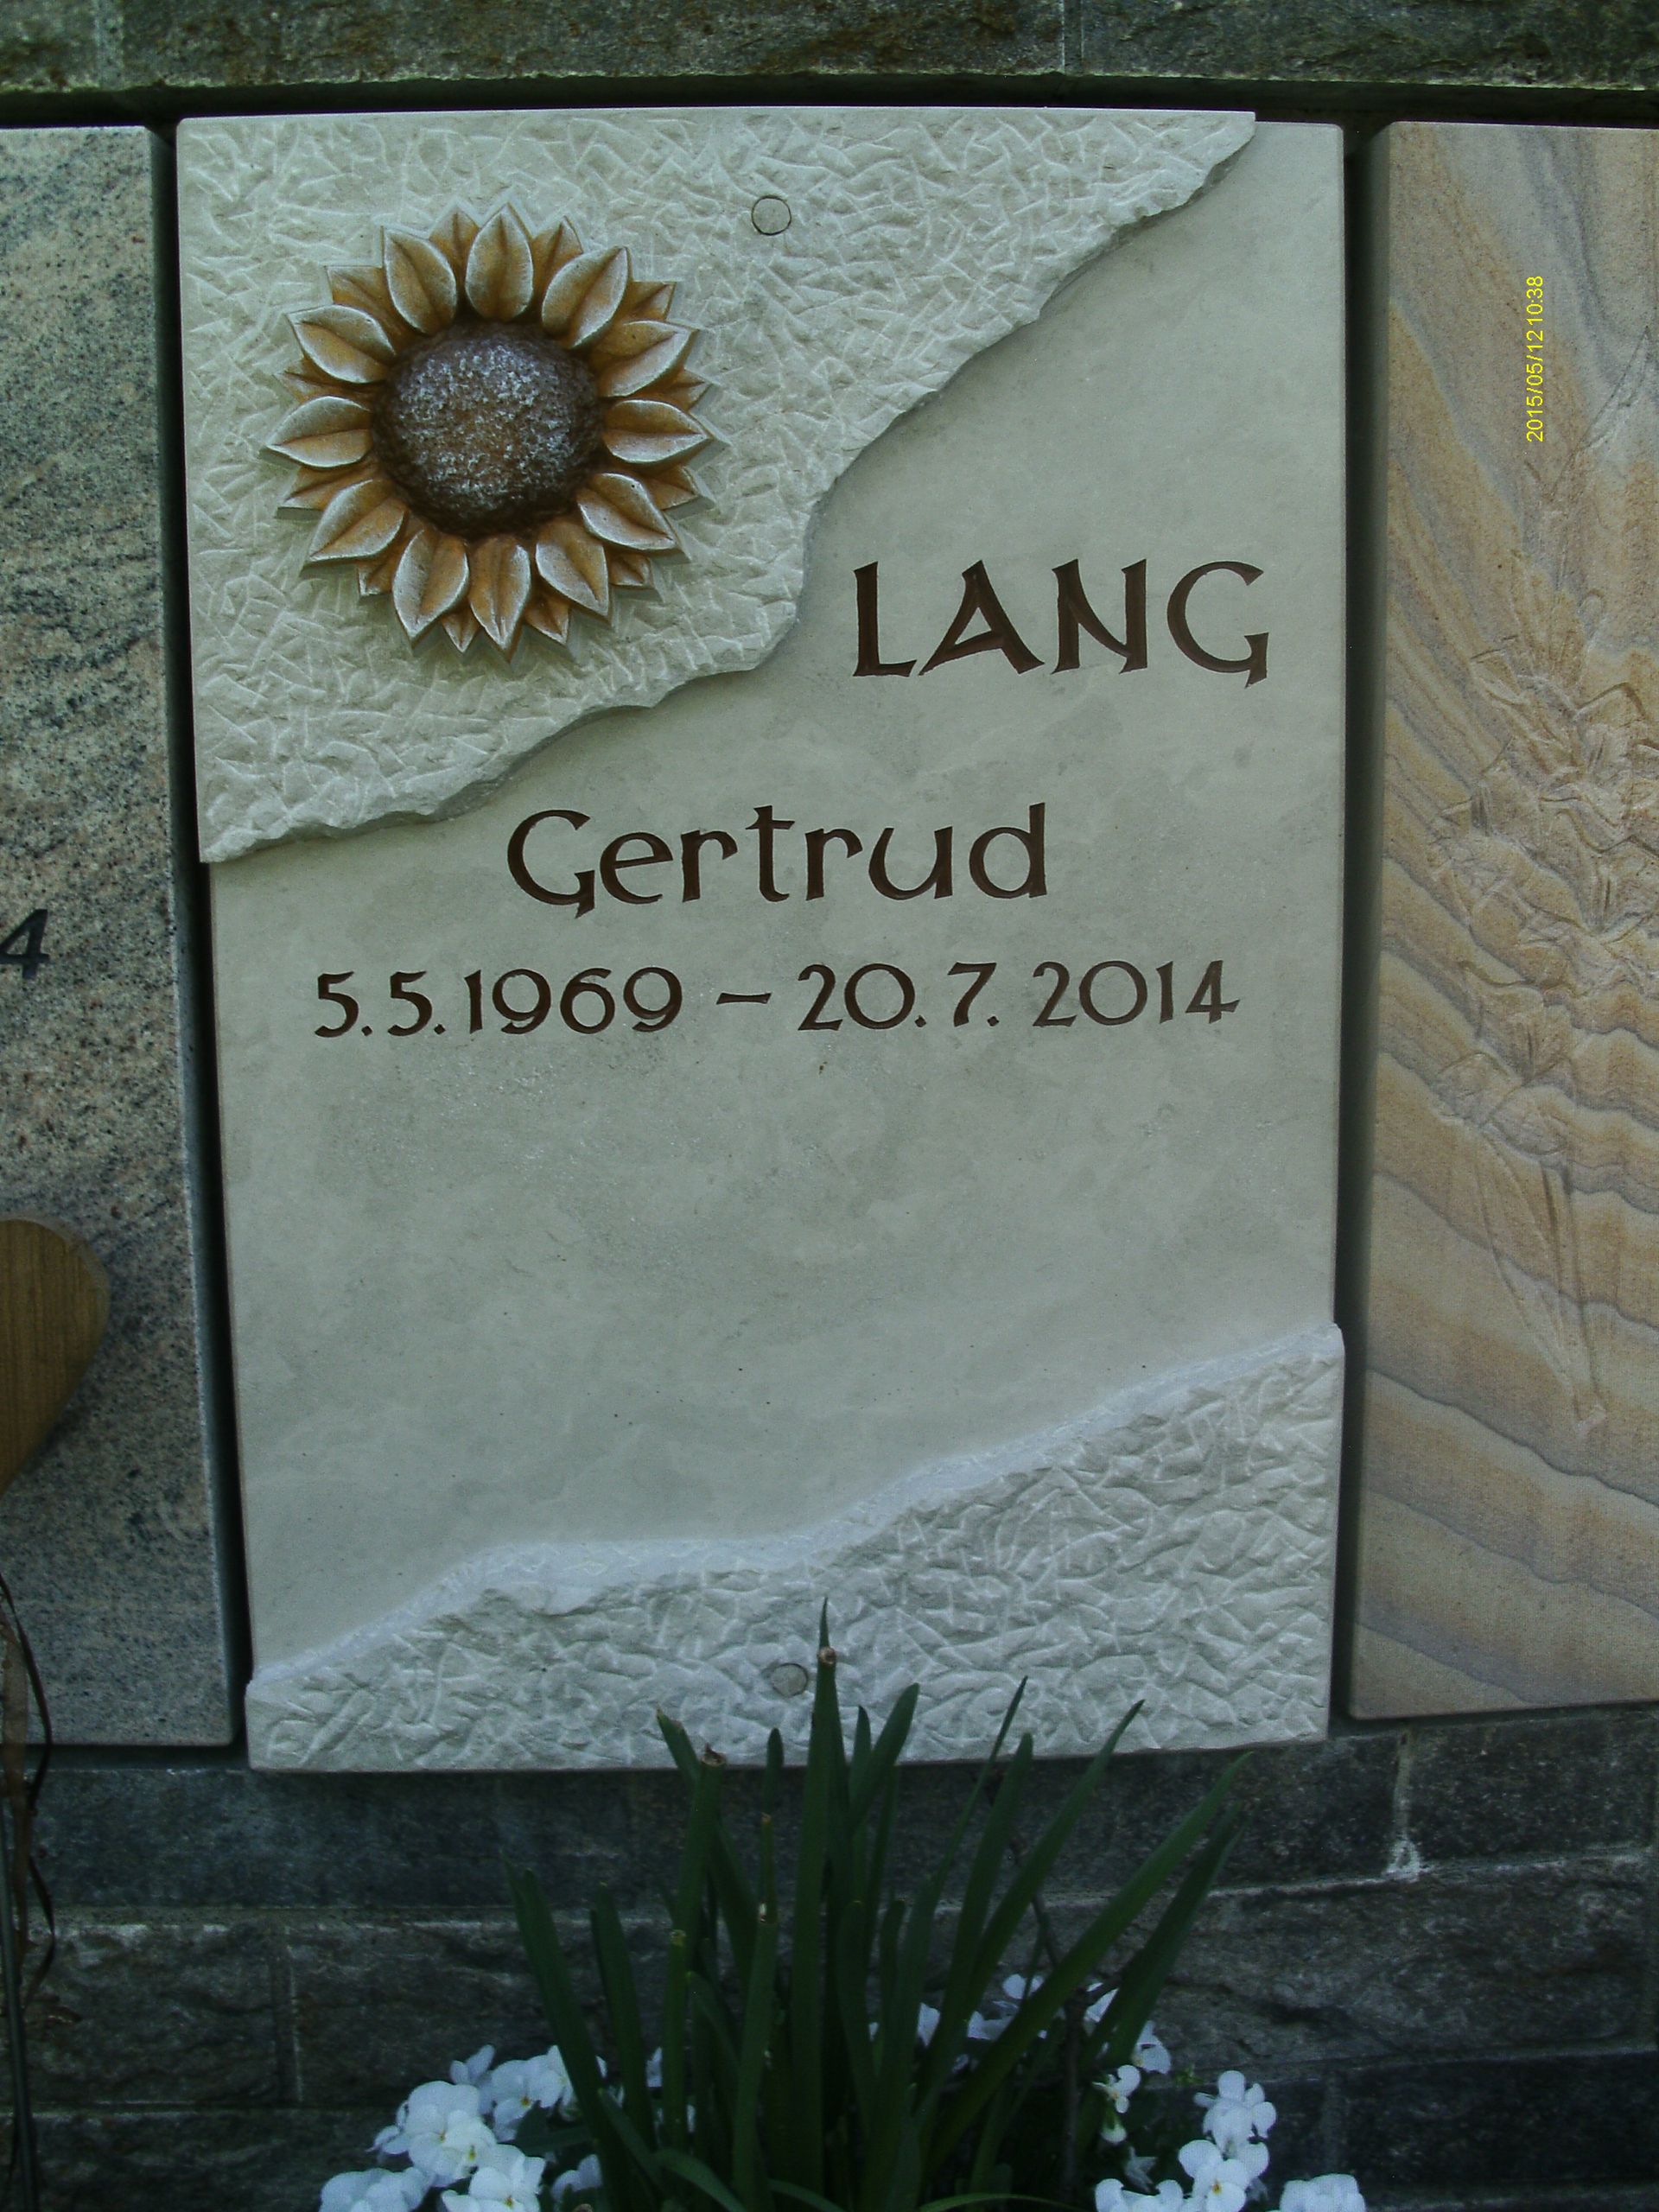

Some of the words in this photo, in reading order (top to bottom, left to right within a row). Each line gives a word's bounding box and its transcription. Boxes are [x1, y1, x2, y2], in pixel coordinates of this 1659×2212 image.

[852, 558, 1269, 689] LANG
[506, 802, 1048, 919] Gertrud
[314, 966, 683, 1039] 5.5.1969
